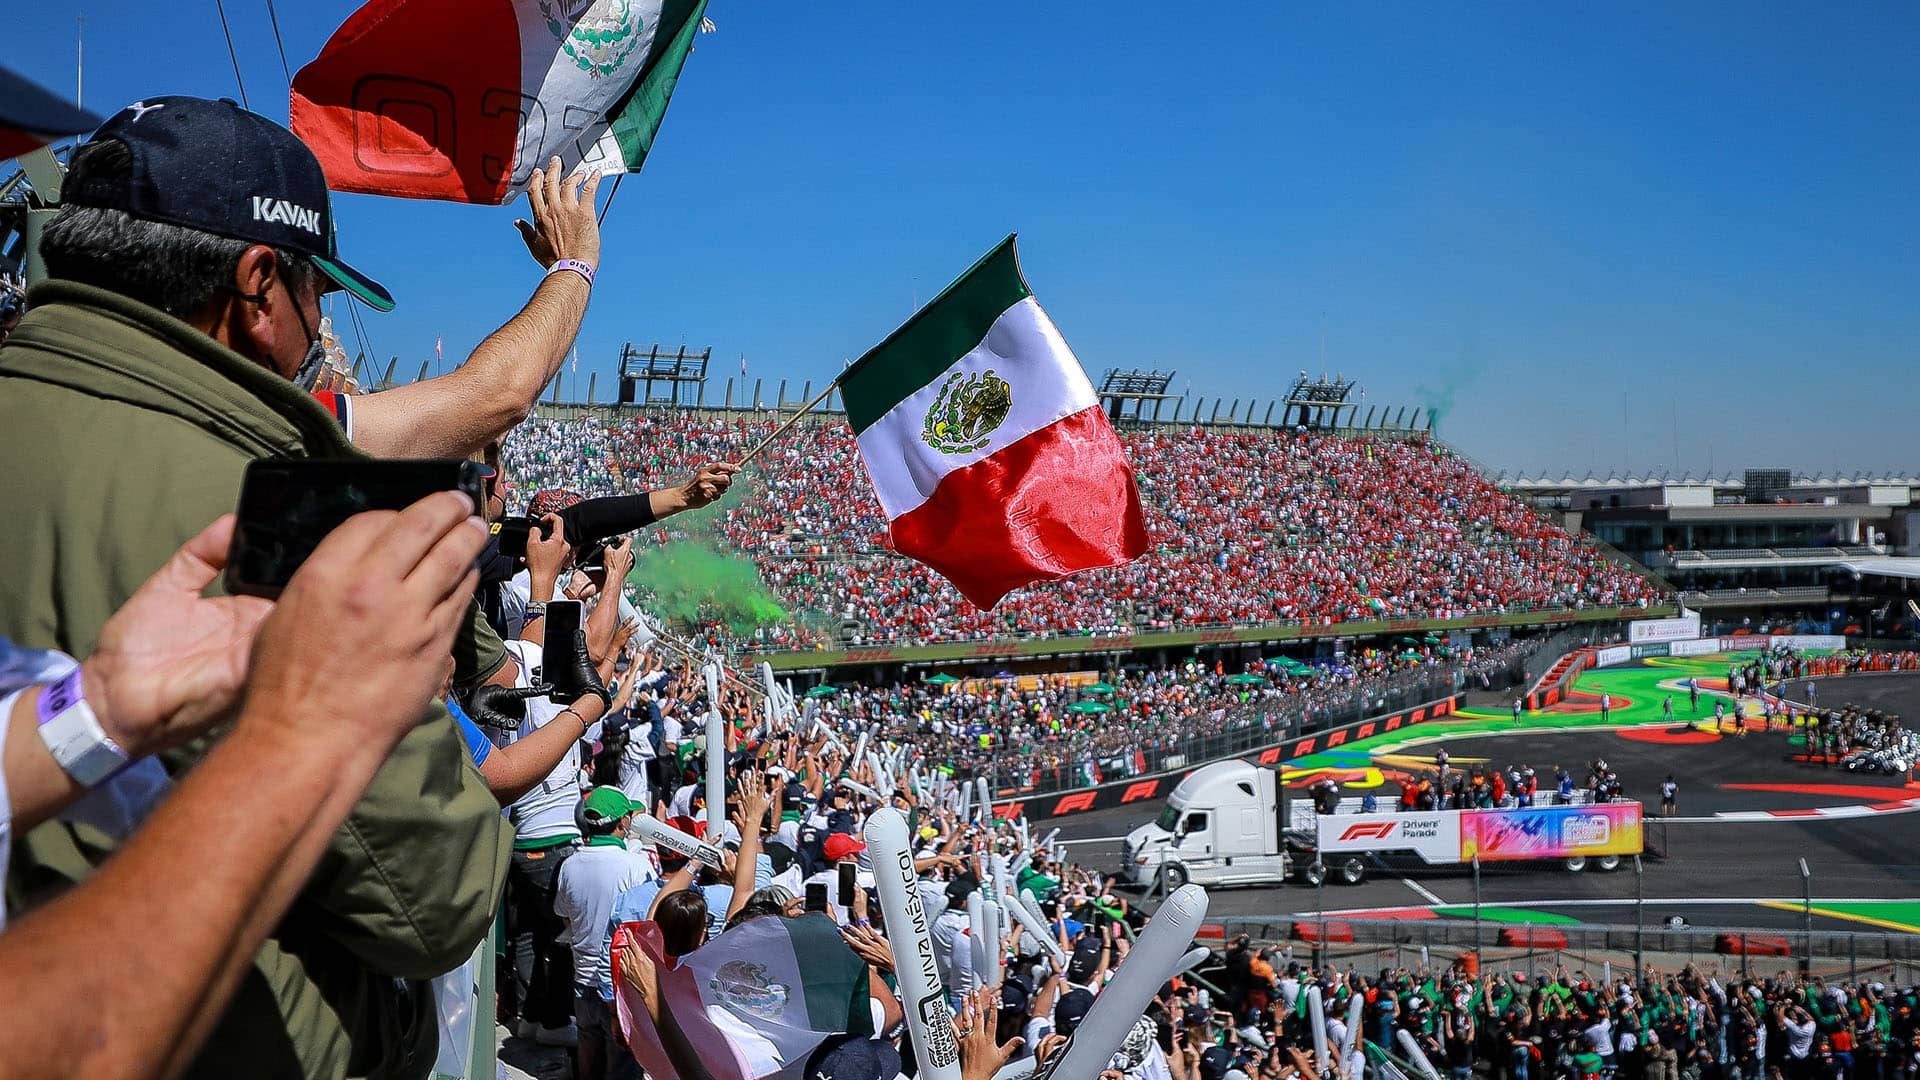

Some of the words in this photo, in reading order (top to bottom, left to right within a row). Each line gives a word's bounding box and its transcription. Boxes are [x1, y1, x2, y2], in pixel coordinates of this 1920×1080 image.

[252, 195, 321, 236] KAVAK
[1052, 791, 1098, 816] F1
[1121, 780, 1160, 803] F1
[1338, 821, 1398, 841] F1
[1402, 830, 1437, 839] Parade
[897, 849, 927, 934] MÉXICO!
[932, 1000, 944, 1038] PREMIO
[929, 1020, 946, 1069] FORMULA
[941, 1038, 951, 1066] GRAN
